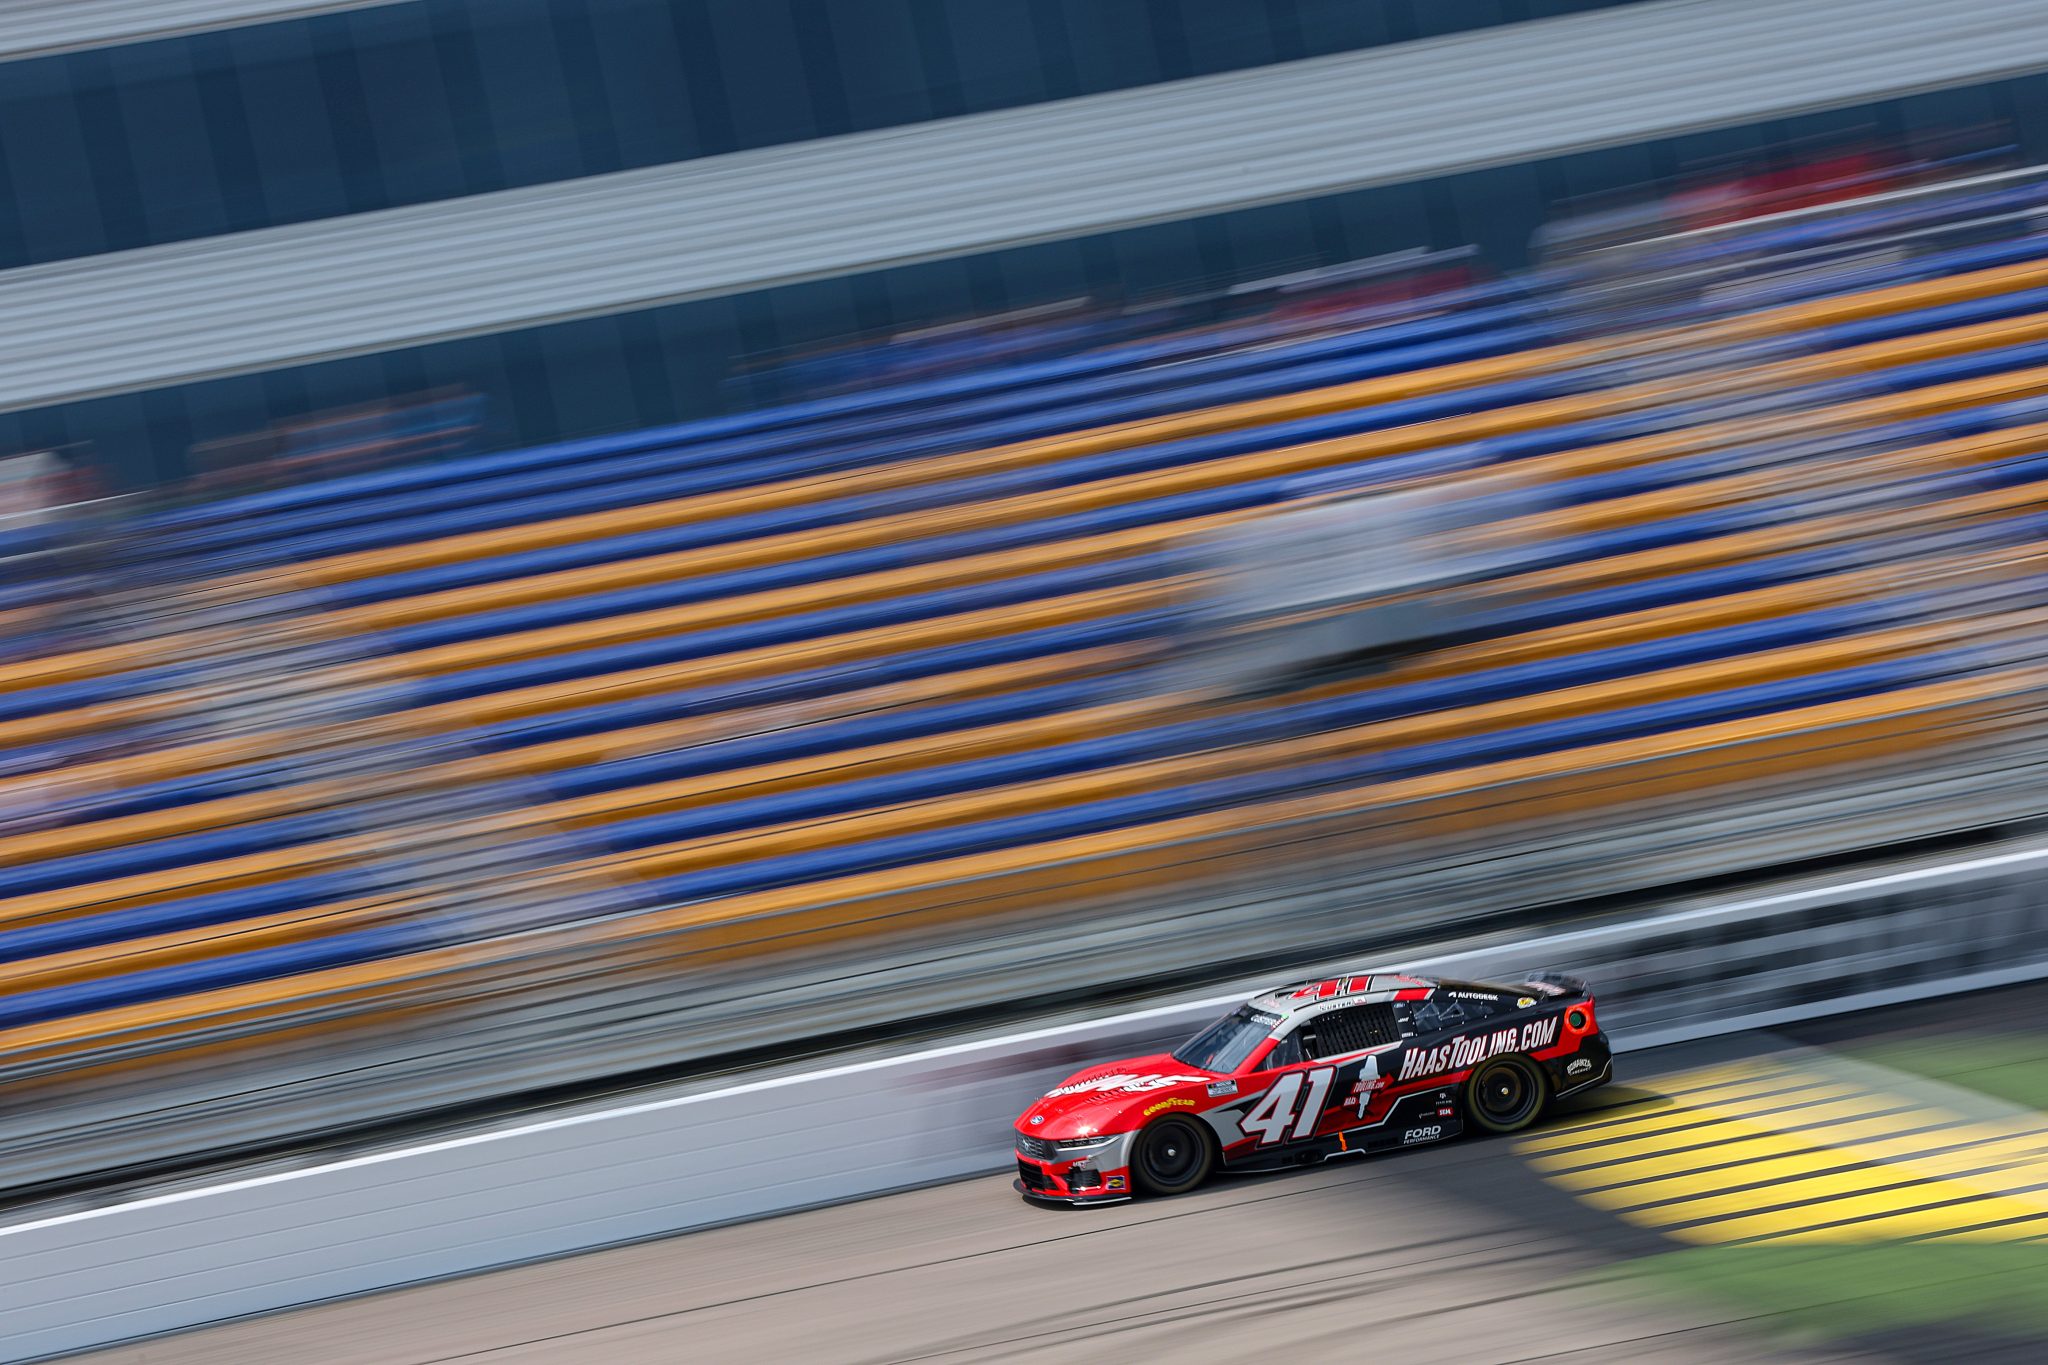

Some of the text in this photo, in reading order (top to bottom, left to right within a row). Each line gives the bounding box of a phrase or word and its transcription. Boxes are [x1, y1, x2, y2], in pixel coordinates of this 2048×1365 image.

[1457, 991, 1499, 1001] AUTODESK
[1566, 1058, 1592, 1076] BONANZA
[1143, 1097, 1196, 1116] GOODYEAR
[1238, 1065, 1337, 1146] 41
[1403, 1134, 1440, 1145] PERFORMANCE
[1404, 1125, 1442, 1140] FORD
